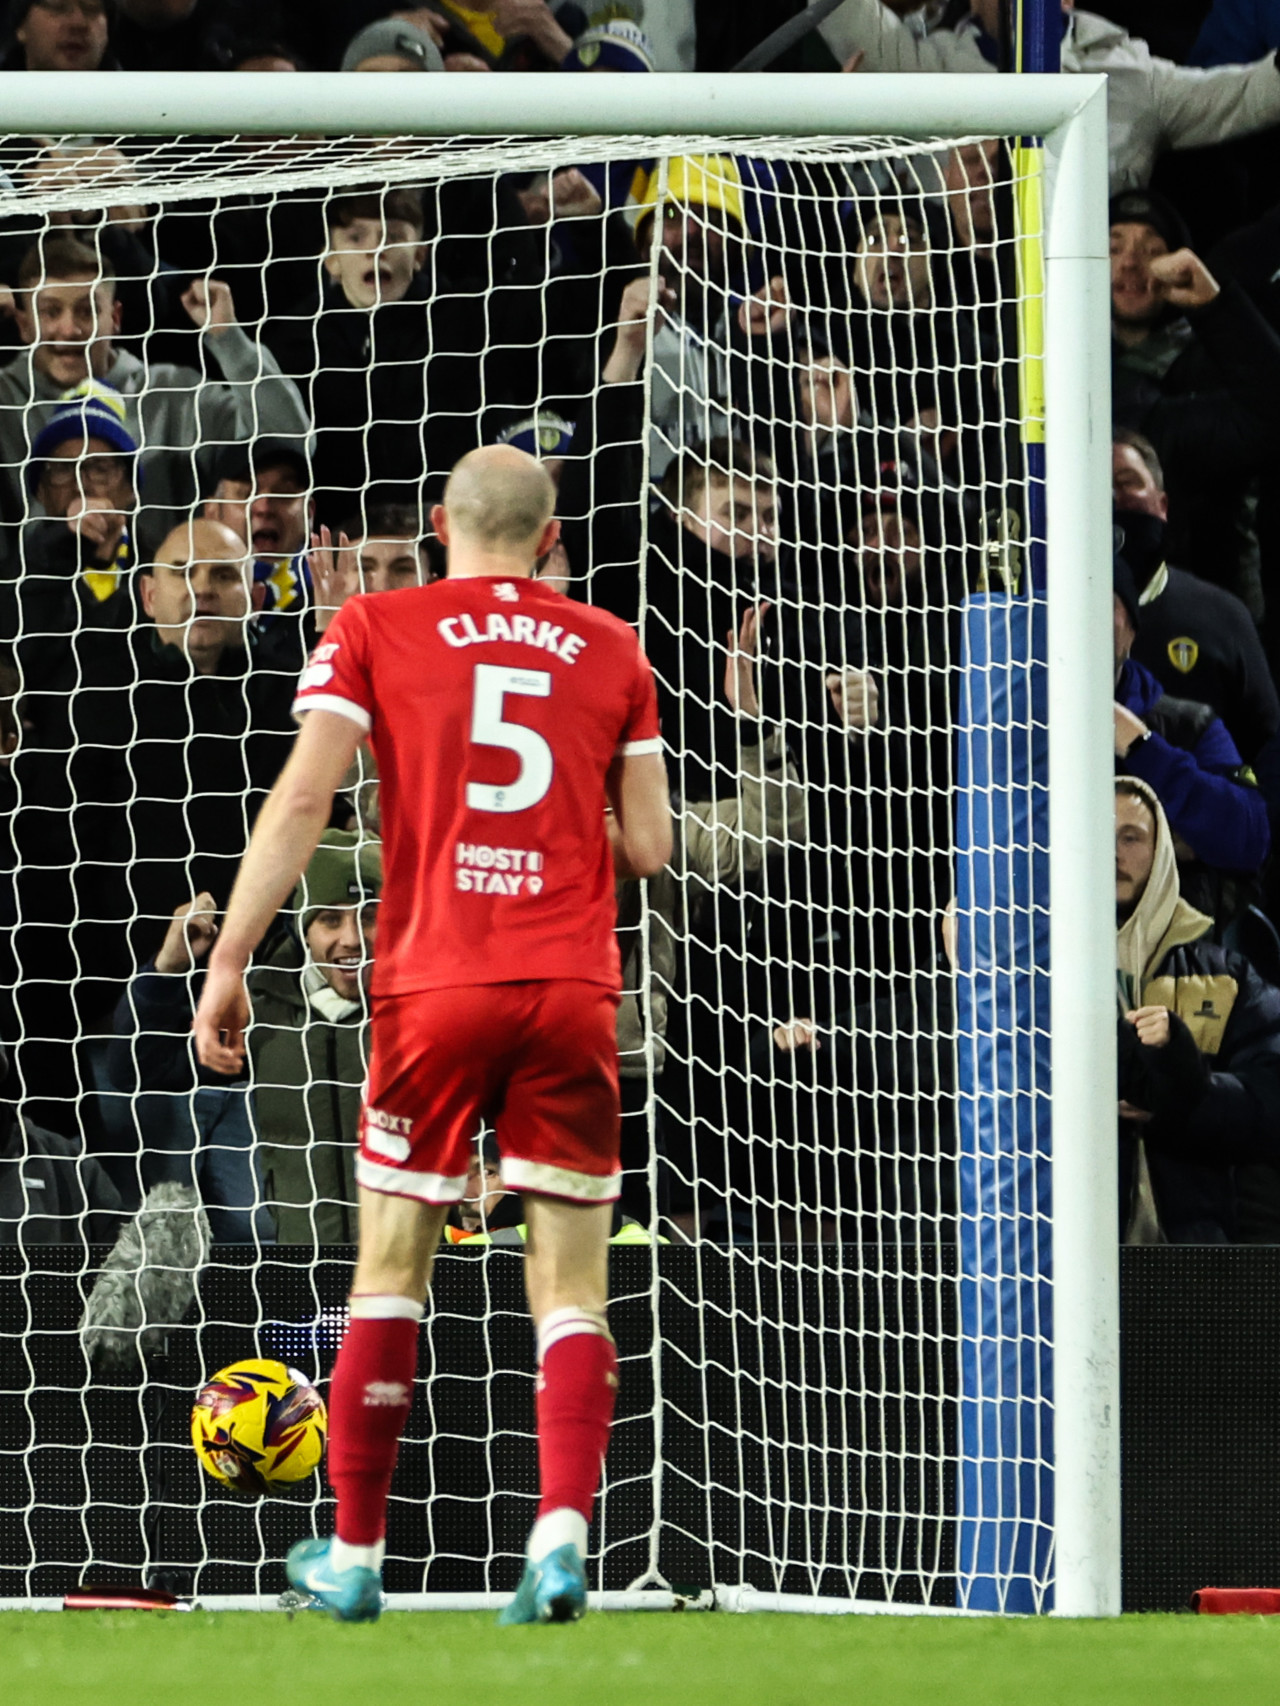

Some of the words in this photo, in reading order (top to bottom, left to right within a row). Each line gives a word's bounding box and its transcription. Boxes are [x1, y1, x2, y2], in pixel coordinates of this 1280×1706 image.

[437, 613, 588, 664] CLARKE
[466, 663, 553, 813] 5
[456, 842, 526, 872] HOST
[456, 868, 525, 896] STAY
